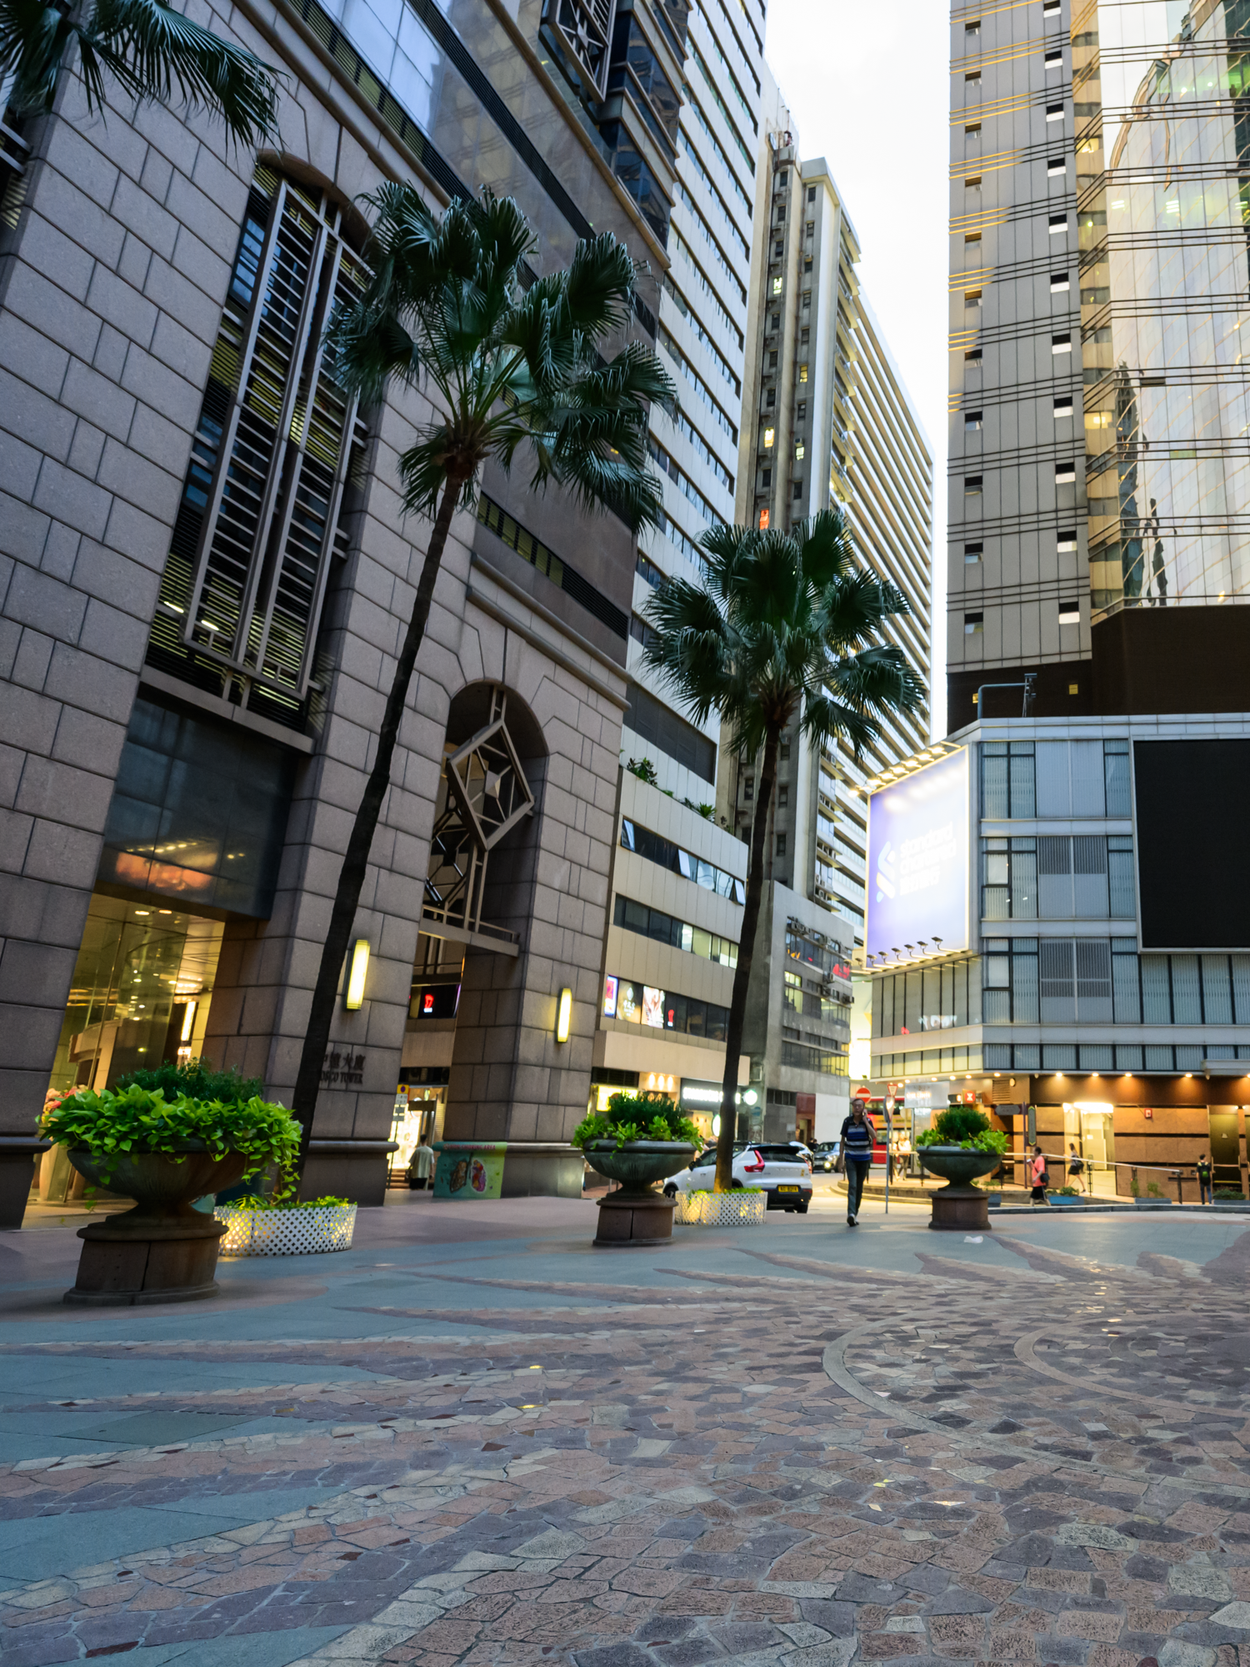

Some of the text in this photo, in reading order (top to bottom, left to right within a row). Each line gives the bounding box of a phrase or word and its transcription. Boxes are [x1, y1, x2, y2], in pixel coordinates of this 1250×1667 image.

[900, 821, 953, 858] standard
[900, 838, 957, 875] chartered
[320, 1070, 339, 1083] OSCO
